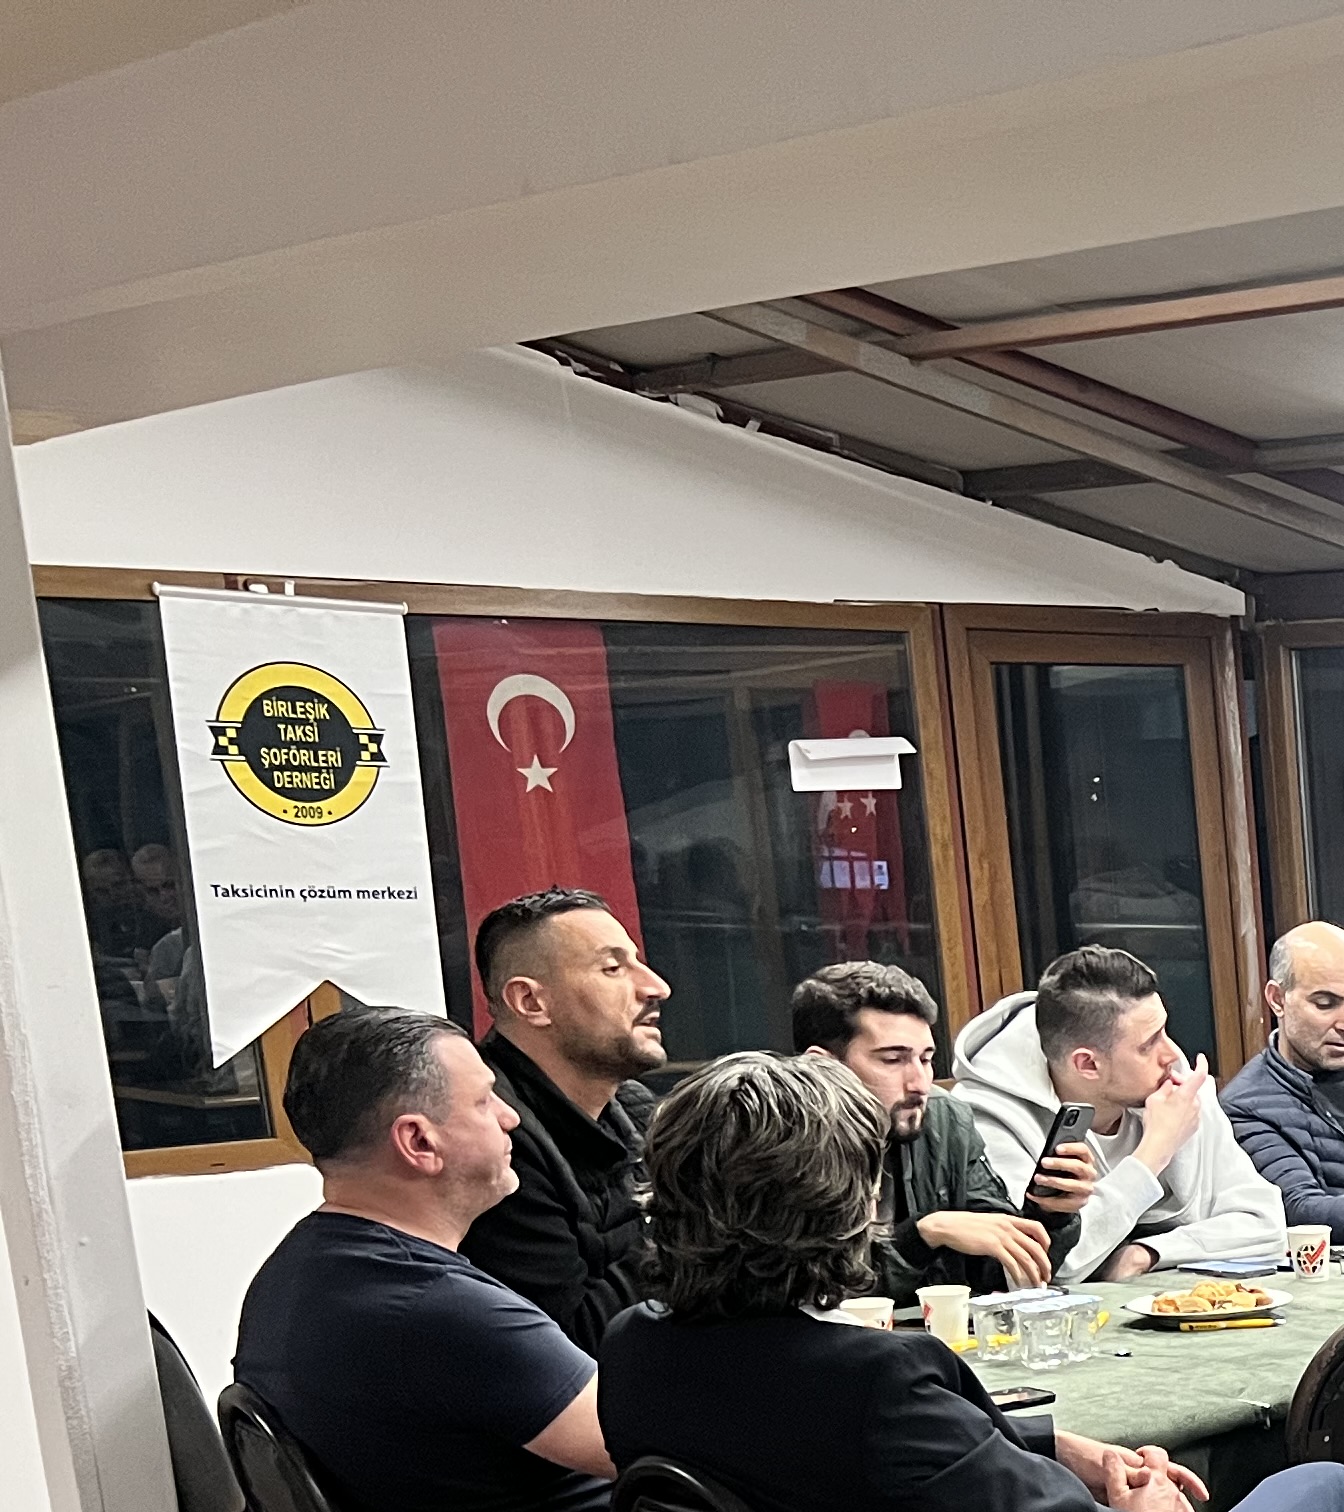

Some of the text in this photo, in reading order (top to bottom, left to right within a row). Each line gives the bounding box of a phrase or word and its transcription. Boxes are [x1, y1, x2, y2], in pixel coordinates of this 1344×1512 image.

[262, 696, 330, 723] BİRLEŞİK
[277, 722, 319, 742] TAKSİ
[260, 745, 342, 768] ŞOFÖRLERİ
[273, 769, 335, 789] DERNEĞİ
[293, 805, 324, 819] 2009
[210, 884, 418, 902] Taksicinin çözüm merkezi
